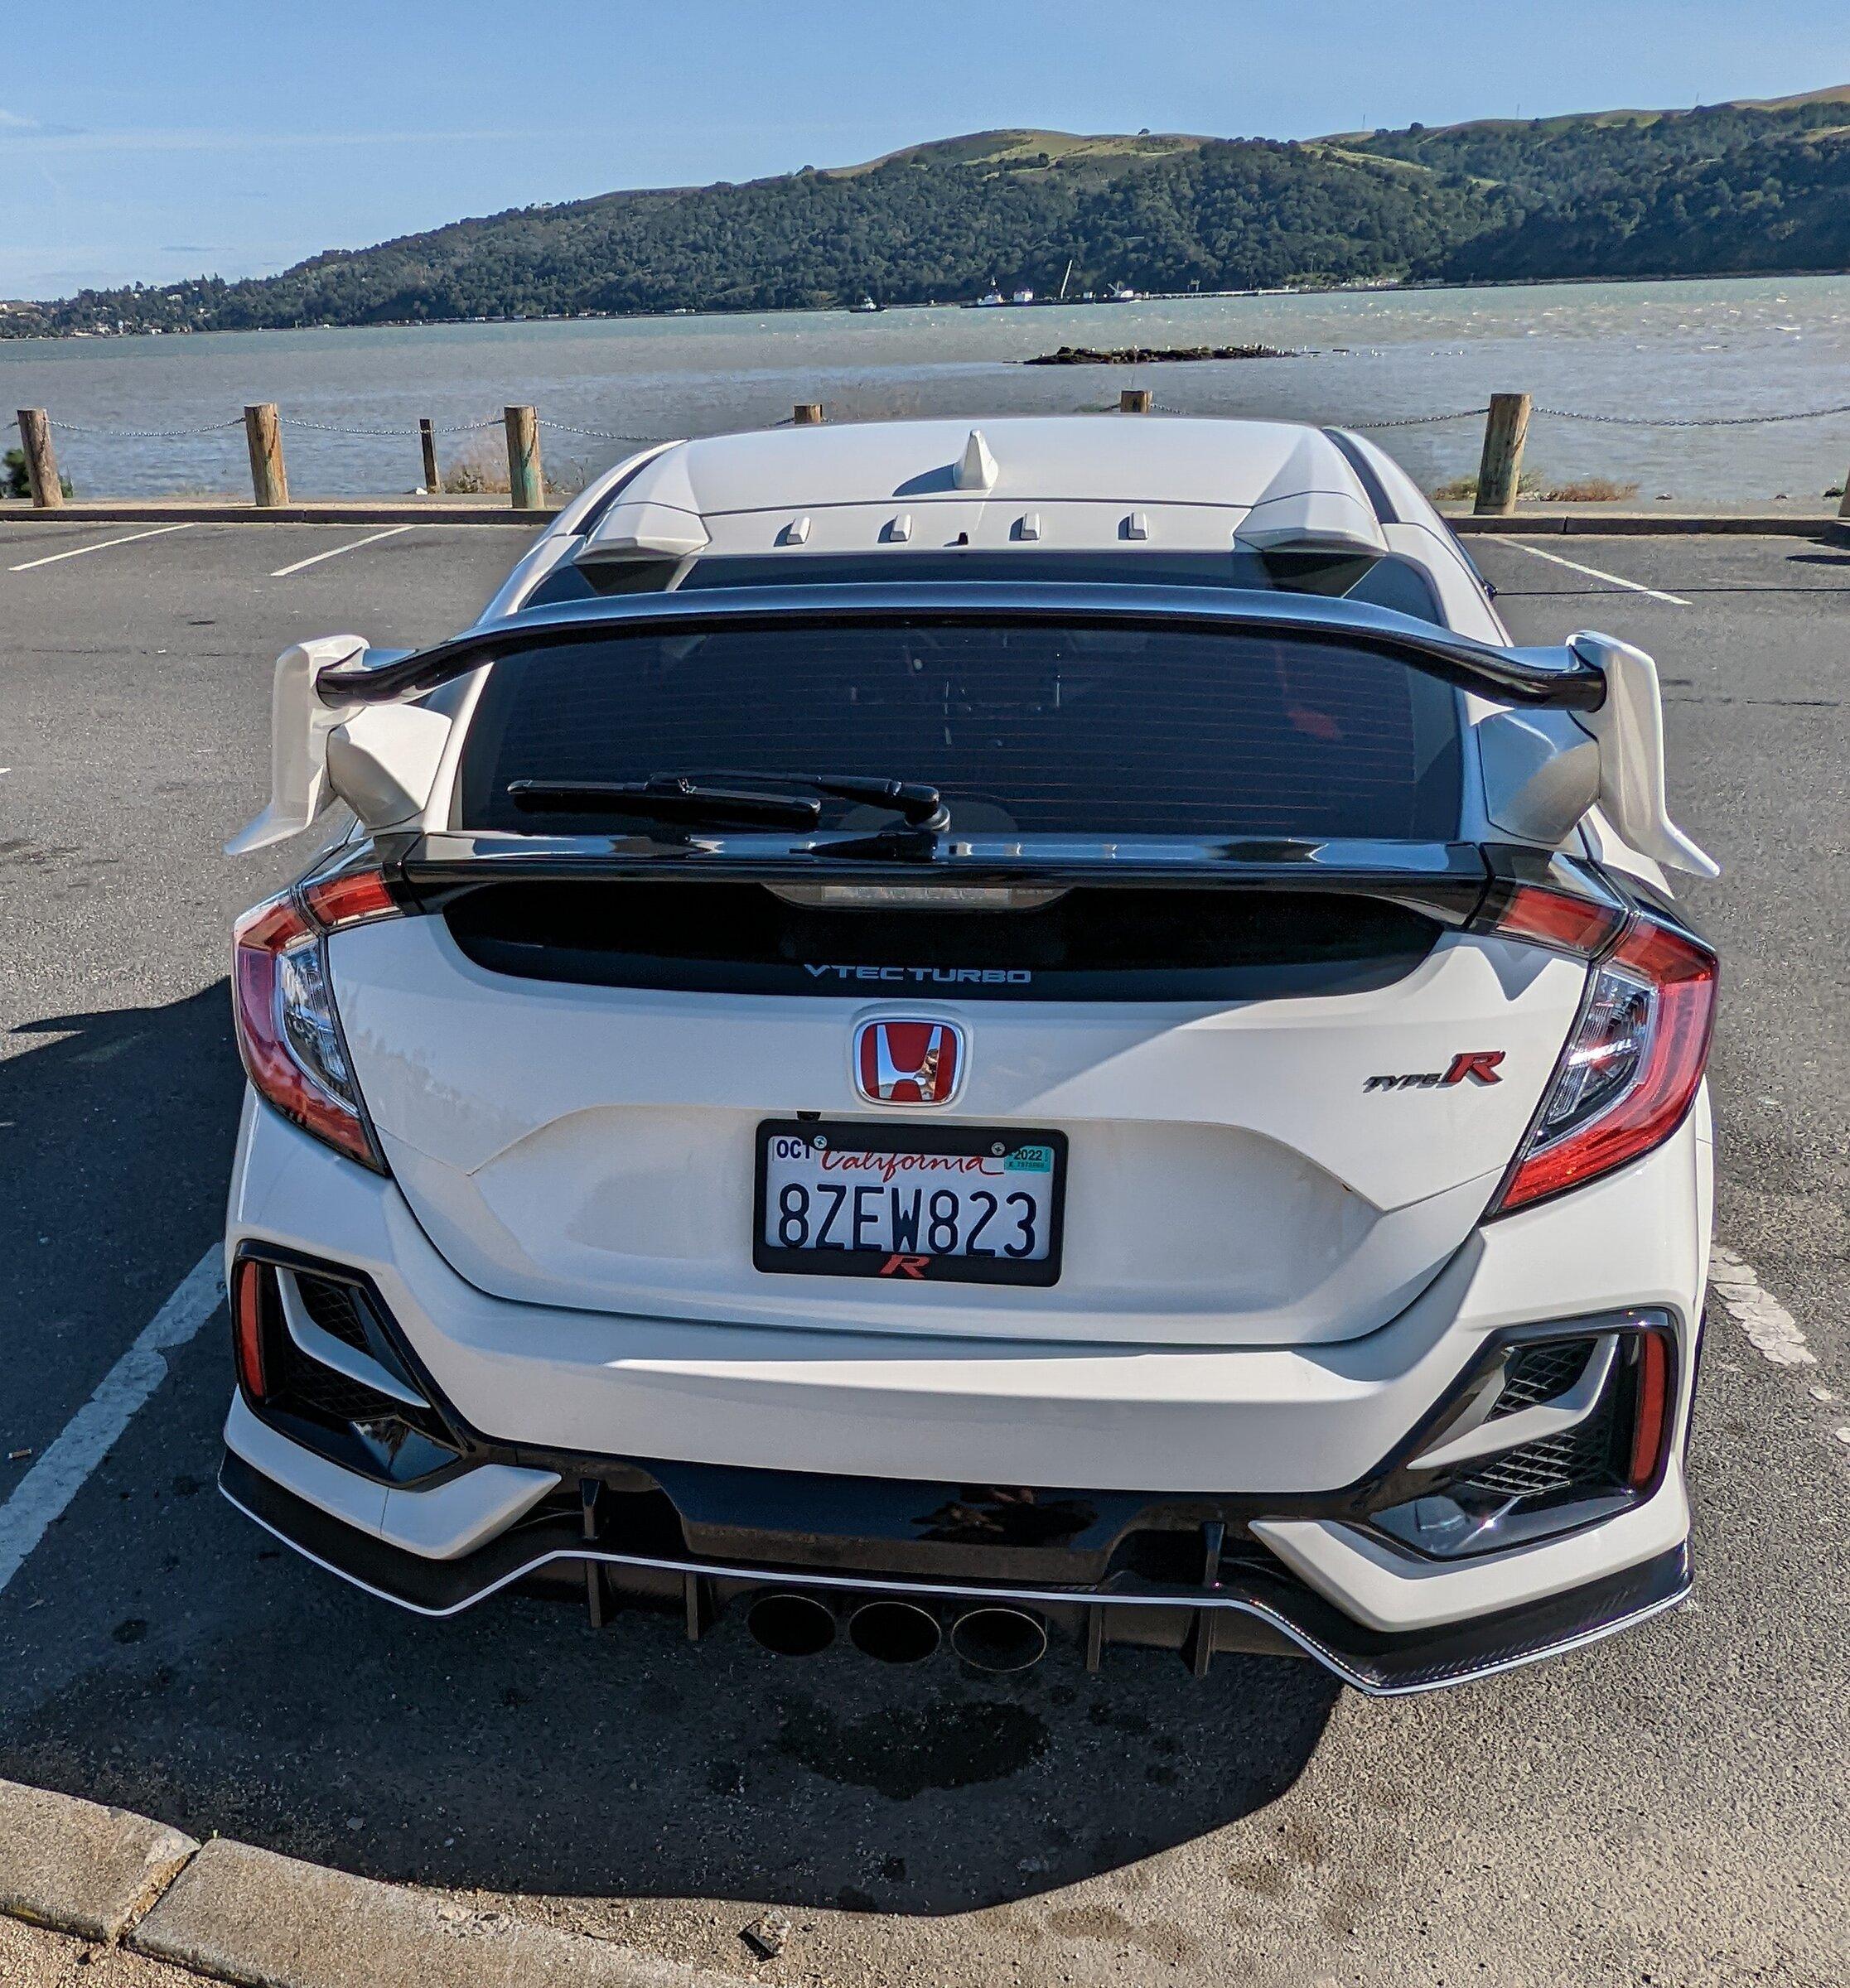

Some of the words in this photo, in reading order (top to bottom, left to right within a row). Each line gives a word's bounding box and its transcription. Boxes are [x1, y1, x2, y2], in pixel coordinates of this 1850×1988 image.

[804, 964, 904, 980] VTEC
[907, 967, 1031, 983] TURBO
[1363, 1073, 1442, 1093] TYPE
[1436, 1050, 1506, 1089] R
[776, 1139, 811, 1160] OCT
[1013, 1149, 1043, 1161] 2022
[820, 1148, 1004, 1183] California
[779, 1183, 1037, 1258] 8ZEW823
[879, 1254, 930, 1279] R
